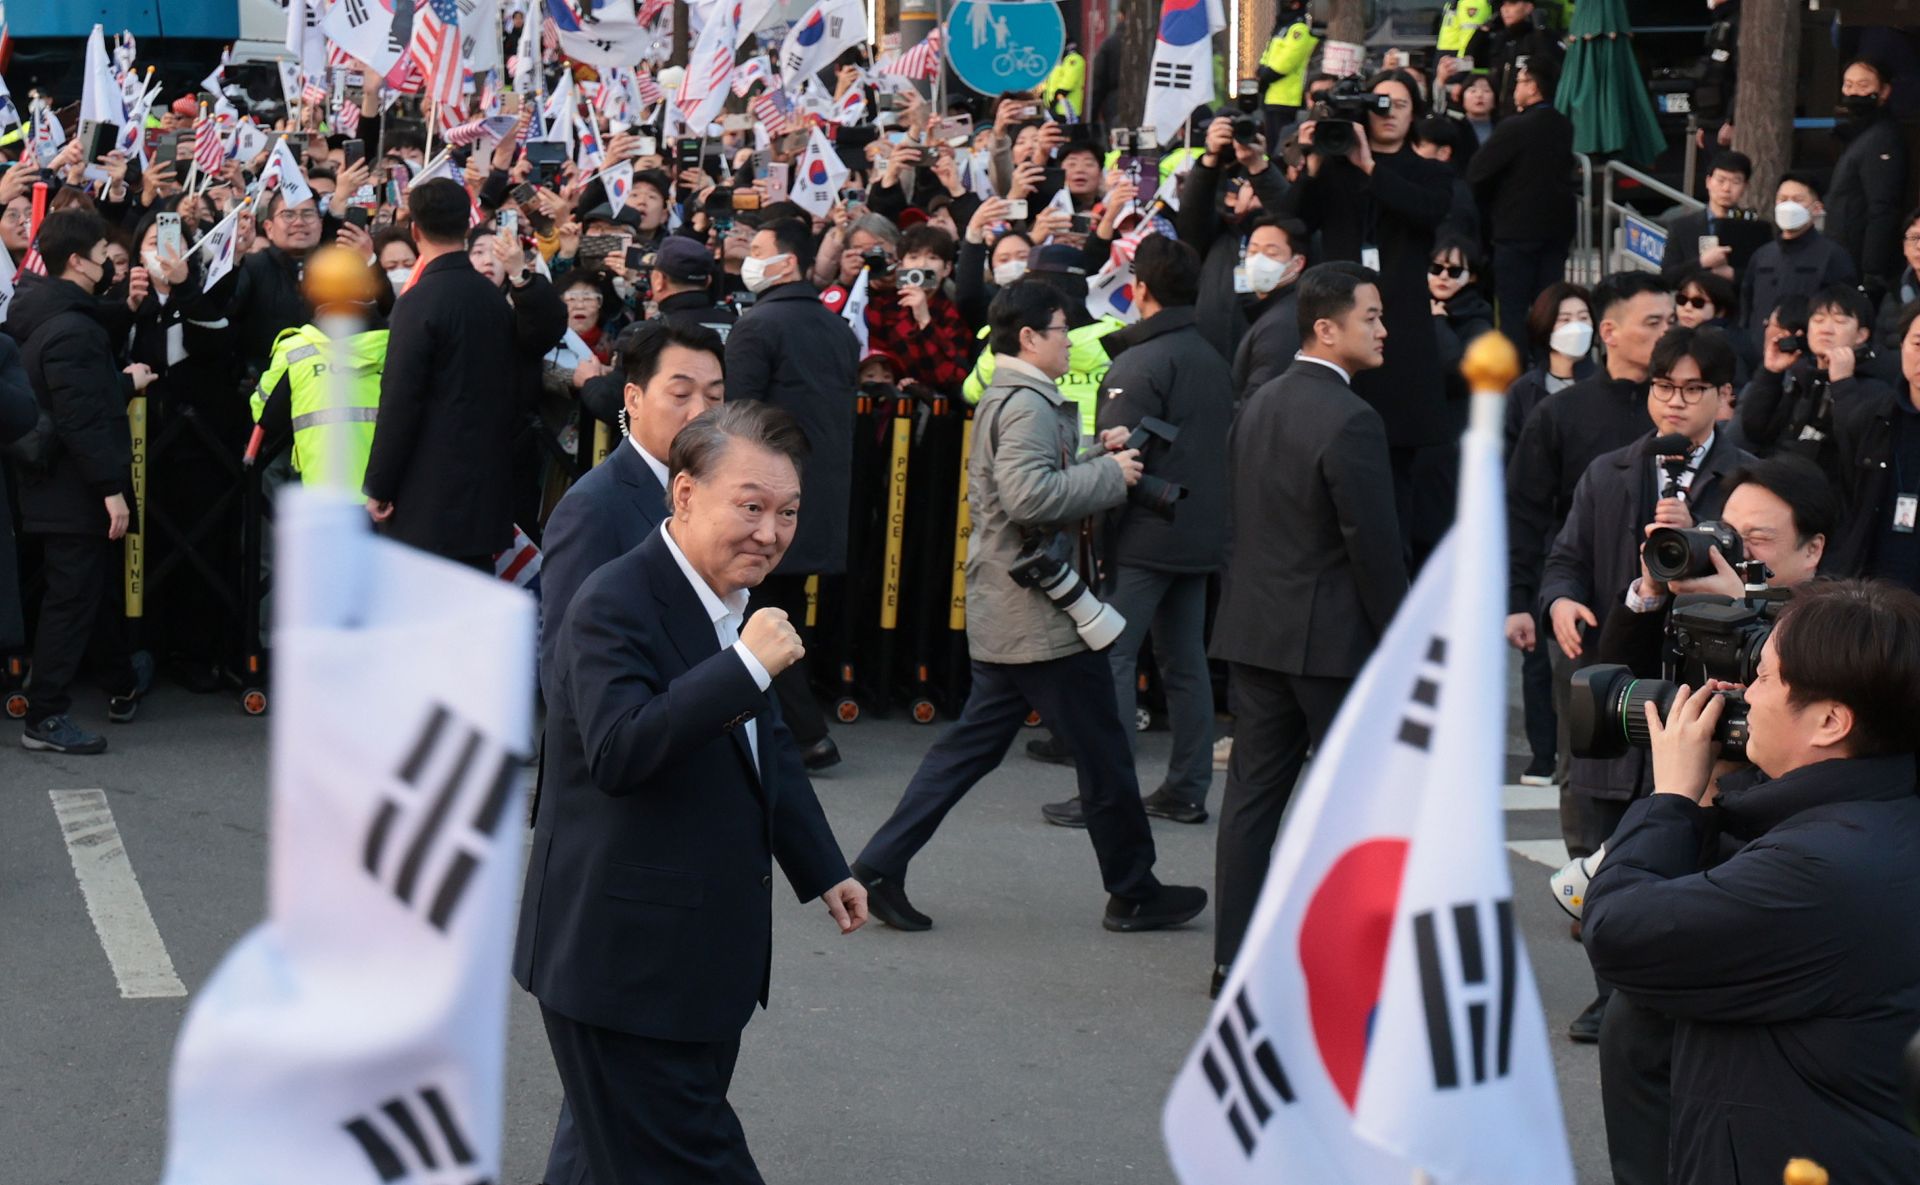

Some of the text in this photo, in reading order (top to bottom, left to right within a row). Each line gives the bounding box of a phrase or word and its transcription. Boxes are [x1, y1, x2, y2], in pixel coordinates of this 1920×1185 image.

[1055, 372, 1105, 386] OLIC
[887, 456, 906, 607] POLICE LINE
[130, 539, 140, 594] LINE
